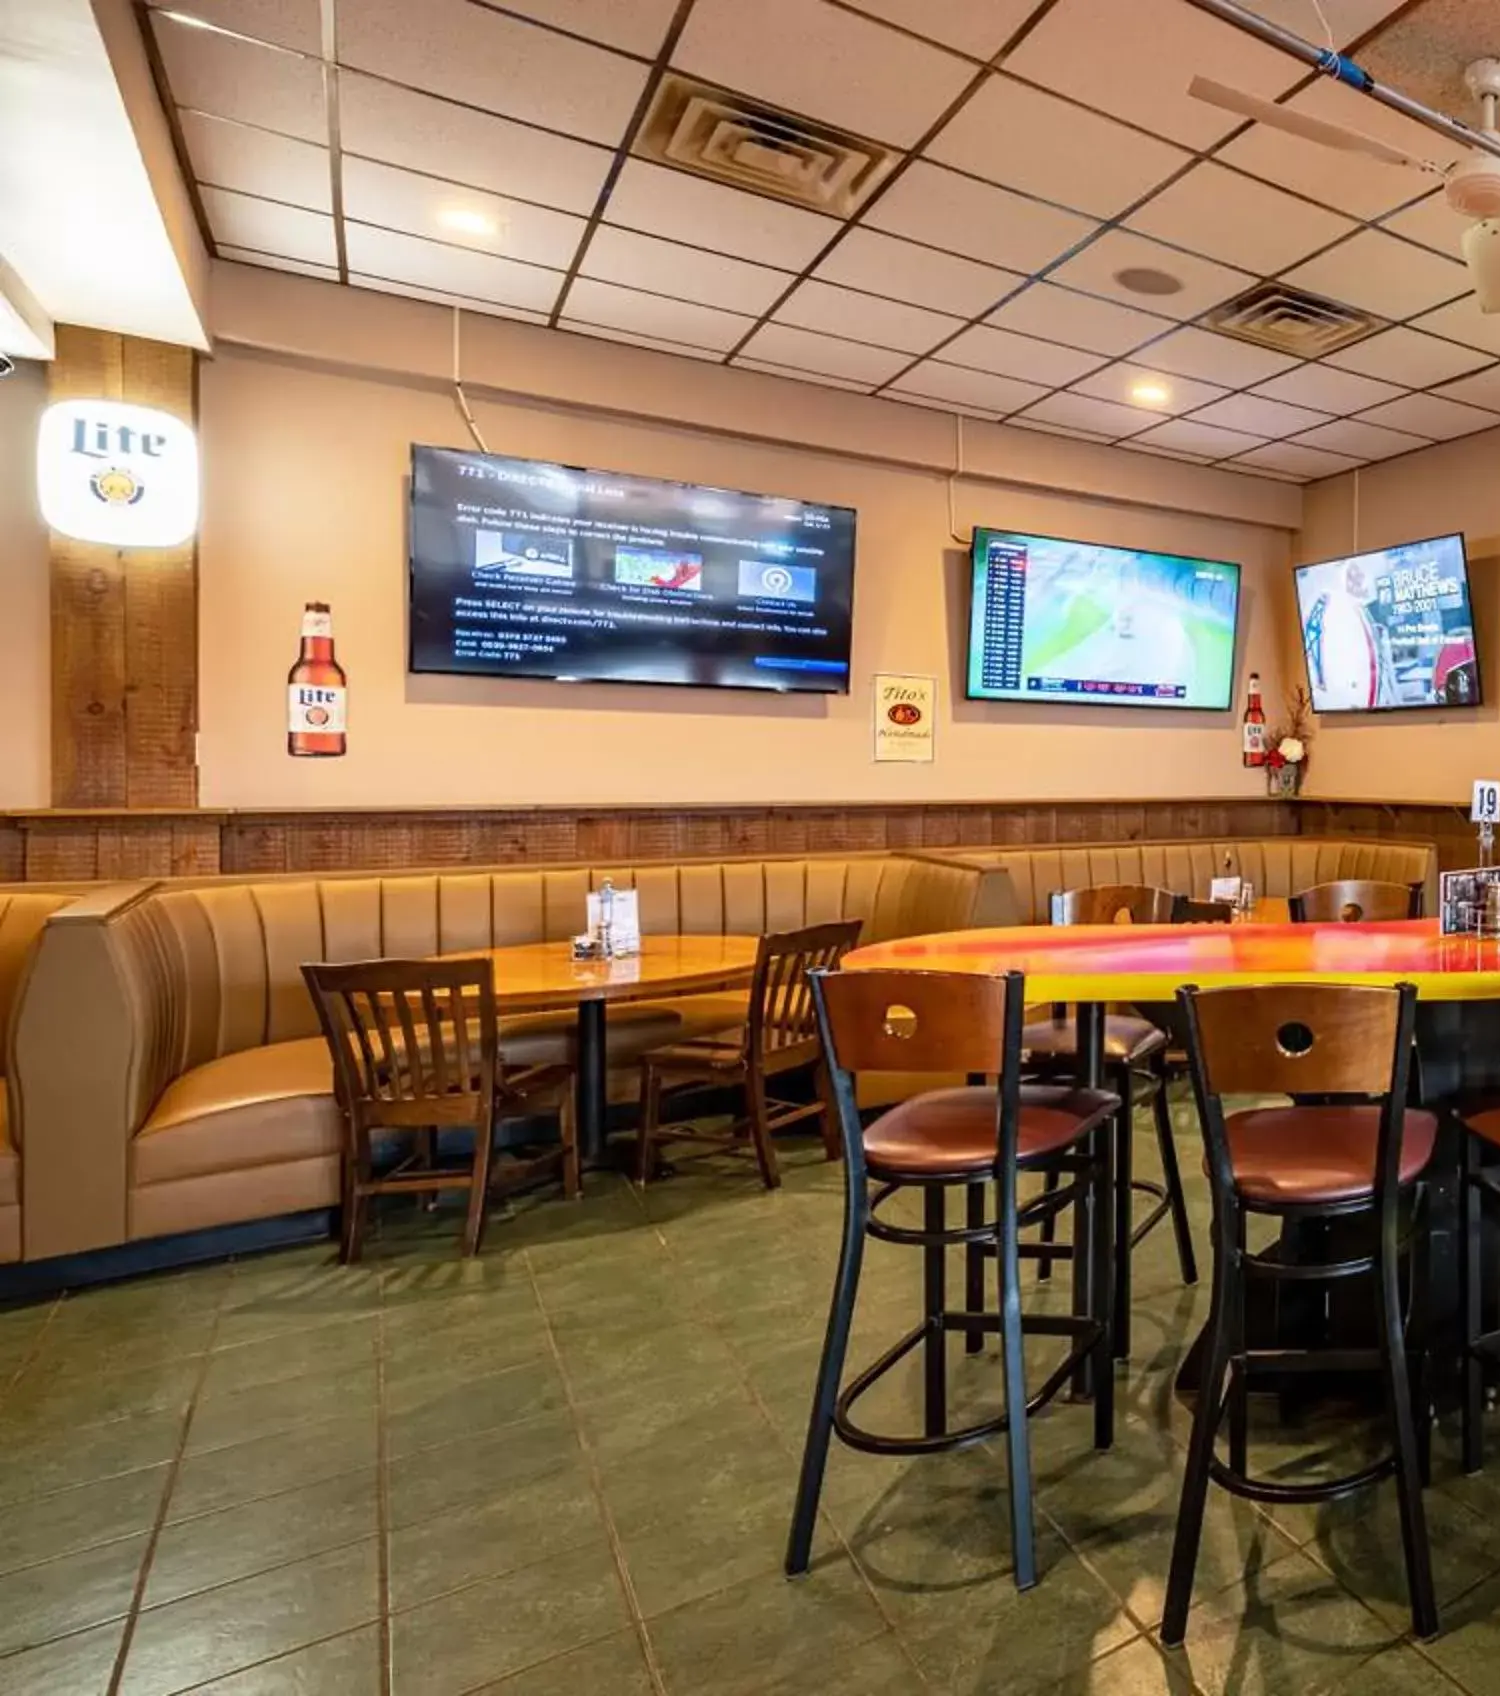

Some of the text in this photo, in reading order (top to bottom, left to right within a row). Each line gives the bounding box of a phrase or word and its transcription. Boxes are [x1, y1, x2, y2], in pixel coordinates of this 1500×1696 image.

[69, 418, 167, 458] Lite
[299, 688, 336, 706] Lite
[1478, 787, 1497, 815] 19
